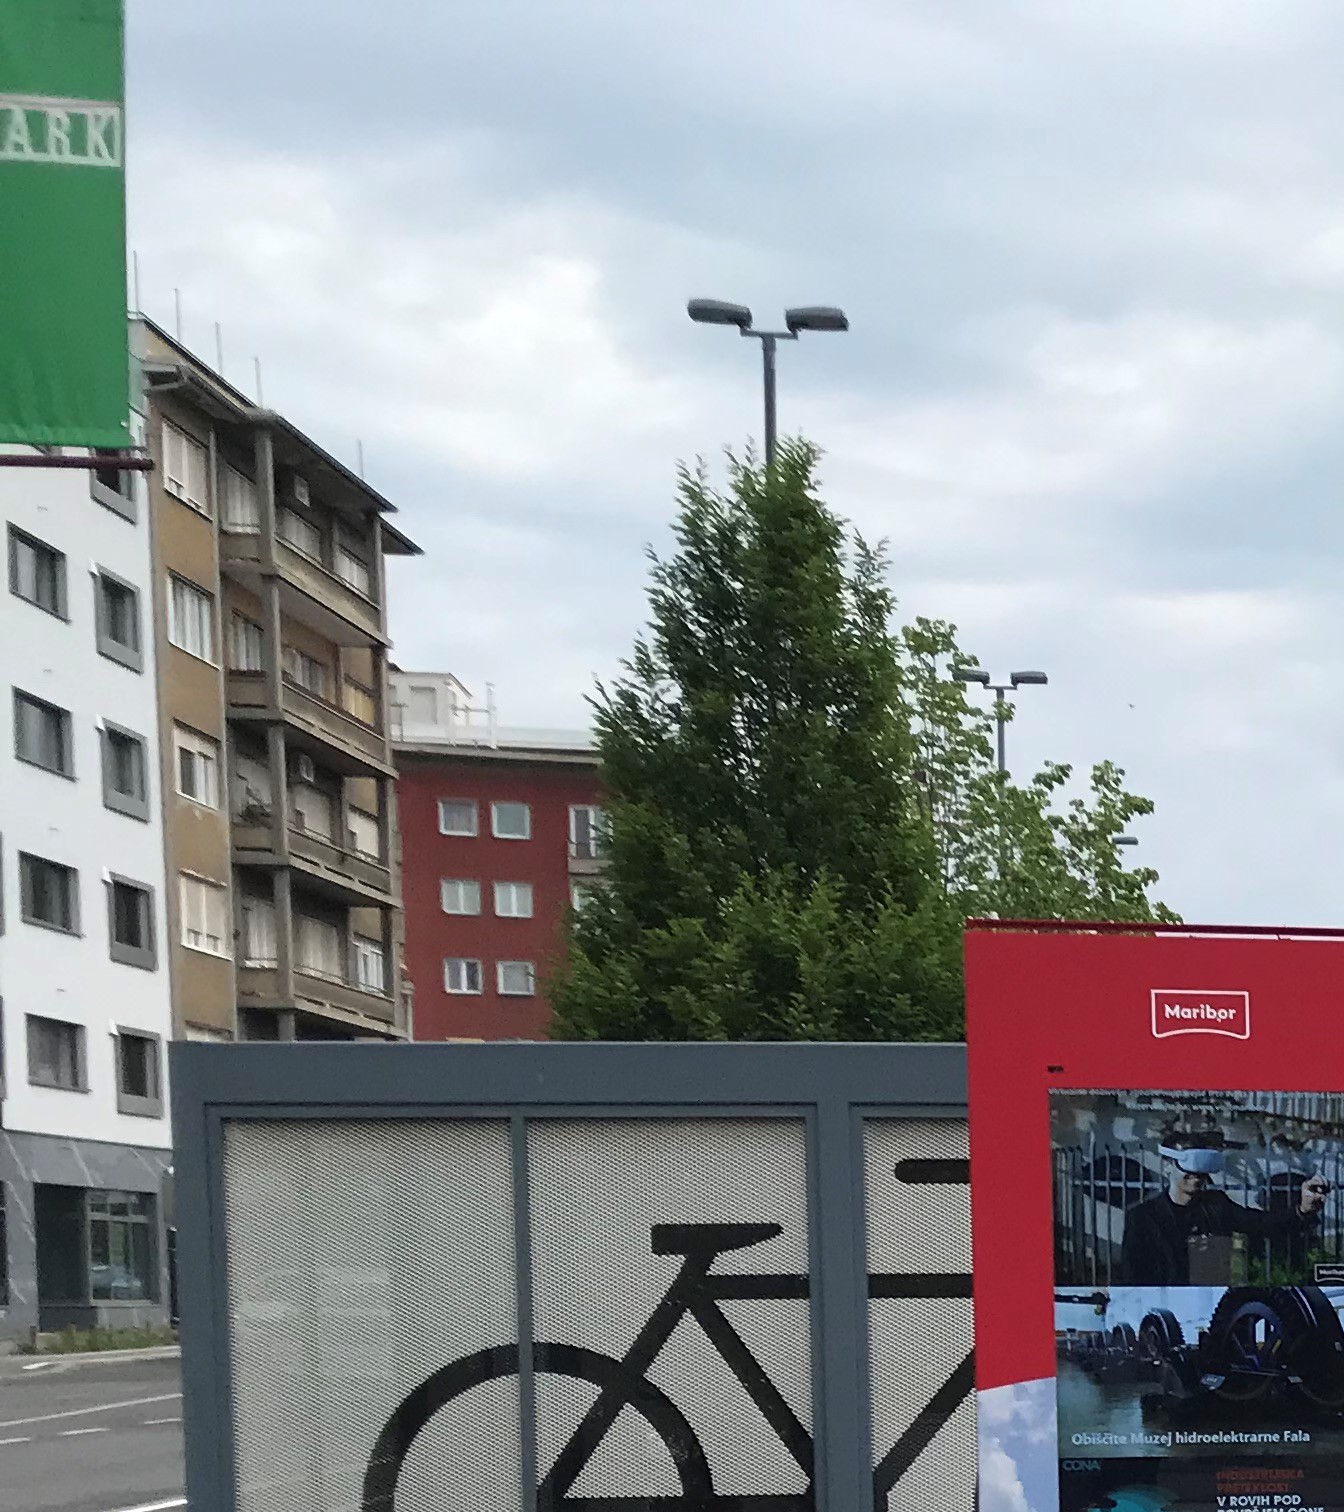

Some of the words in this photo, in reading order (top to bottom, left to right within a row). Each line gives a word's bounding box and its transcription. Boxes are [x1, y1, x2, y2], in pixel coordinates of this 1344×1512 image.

[1164, 1003, 1236, 1022] Maribor
[1130, 1431, 1172, 1447] Muzej
[1175, 1430, 1280, 1445] hidroelektrarne
[1283, 1430, 1311, 1443] Fala
[1062, 1459, 1101, 1471] CONA
[1216, 1496, 1227, 1507] V
[1229, 1495, 1270, 1506] ROVIH
[1273, 1495, 1302, 1505] POD
